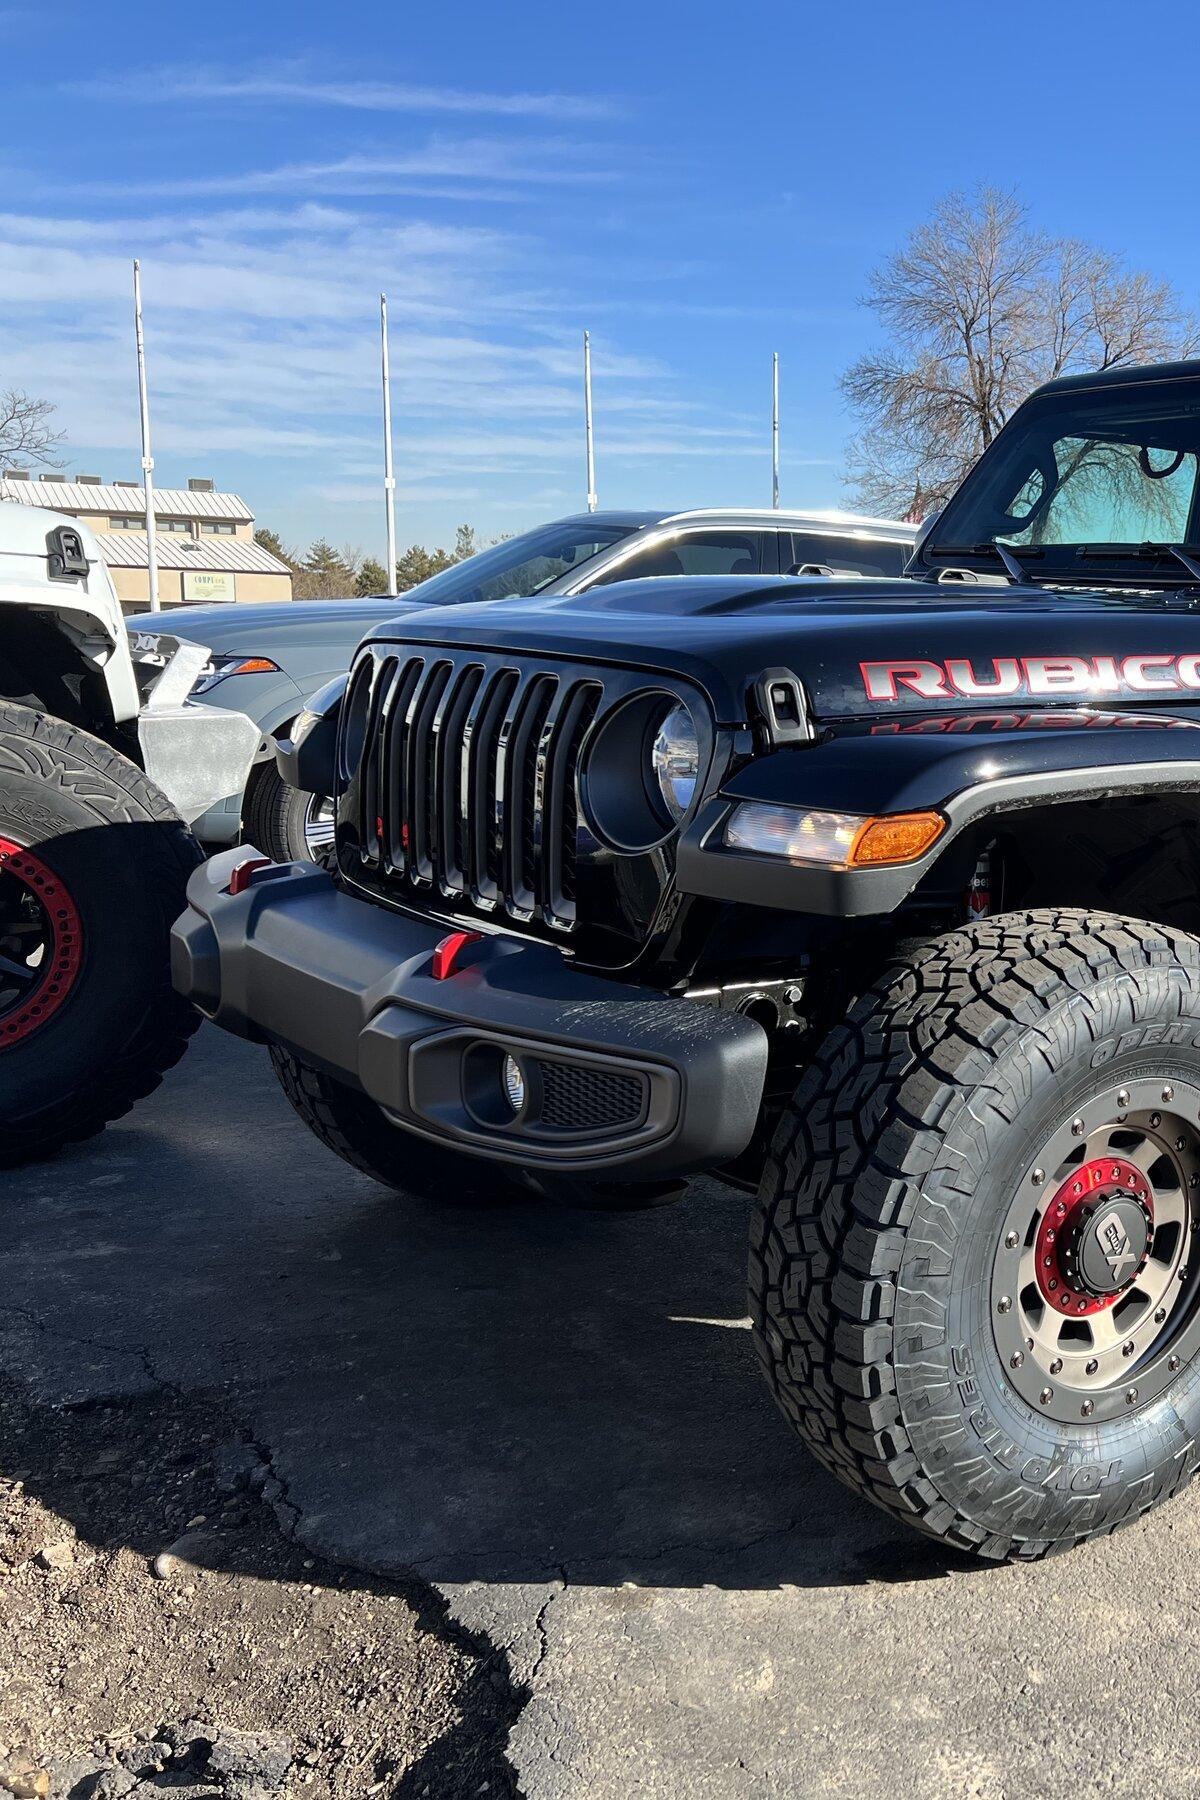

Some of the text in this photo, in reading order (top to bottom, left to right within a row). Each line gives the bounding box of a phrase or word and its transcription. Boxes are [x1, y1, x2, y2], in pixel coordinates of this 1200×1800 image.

[1090, 1022, 1192, 1069] OPEN
[951, 1343, 1022, 1472] TIRES
[1020, 1457, 1125, 1492] TOYO
